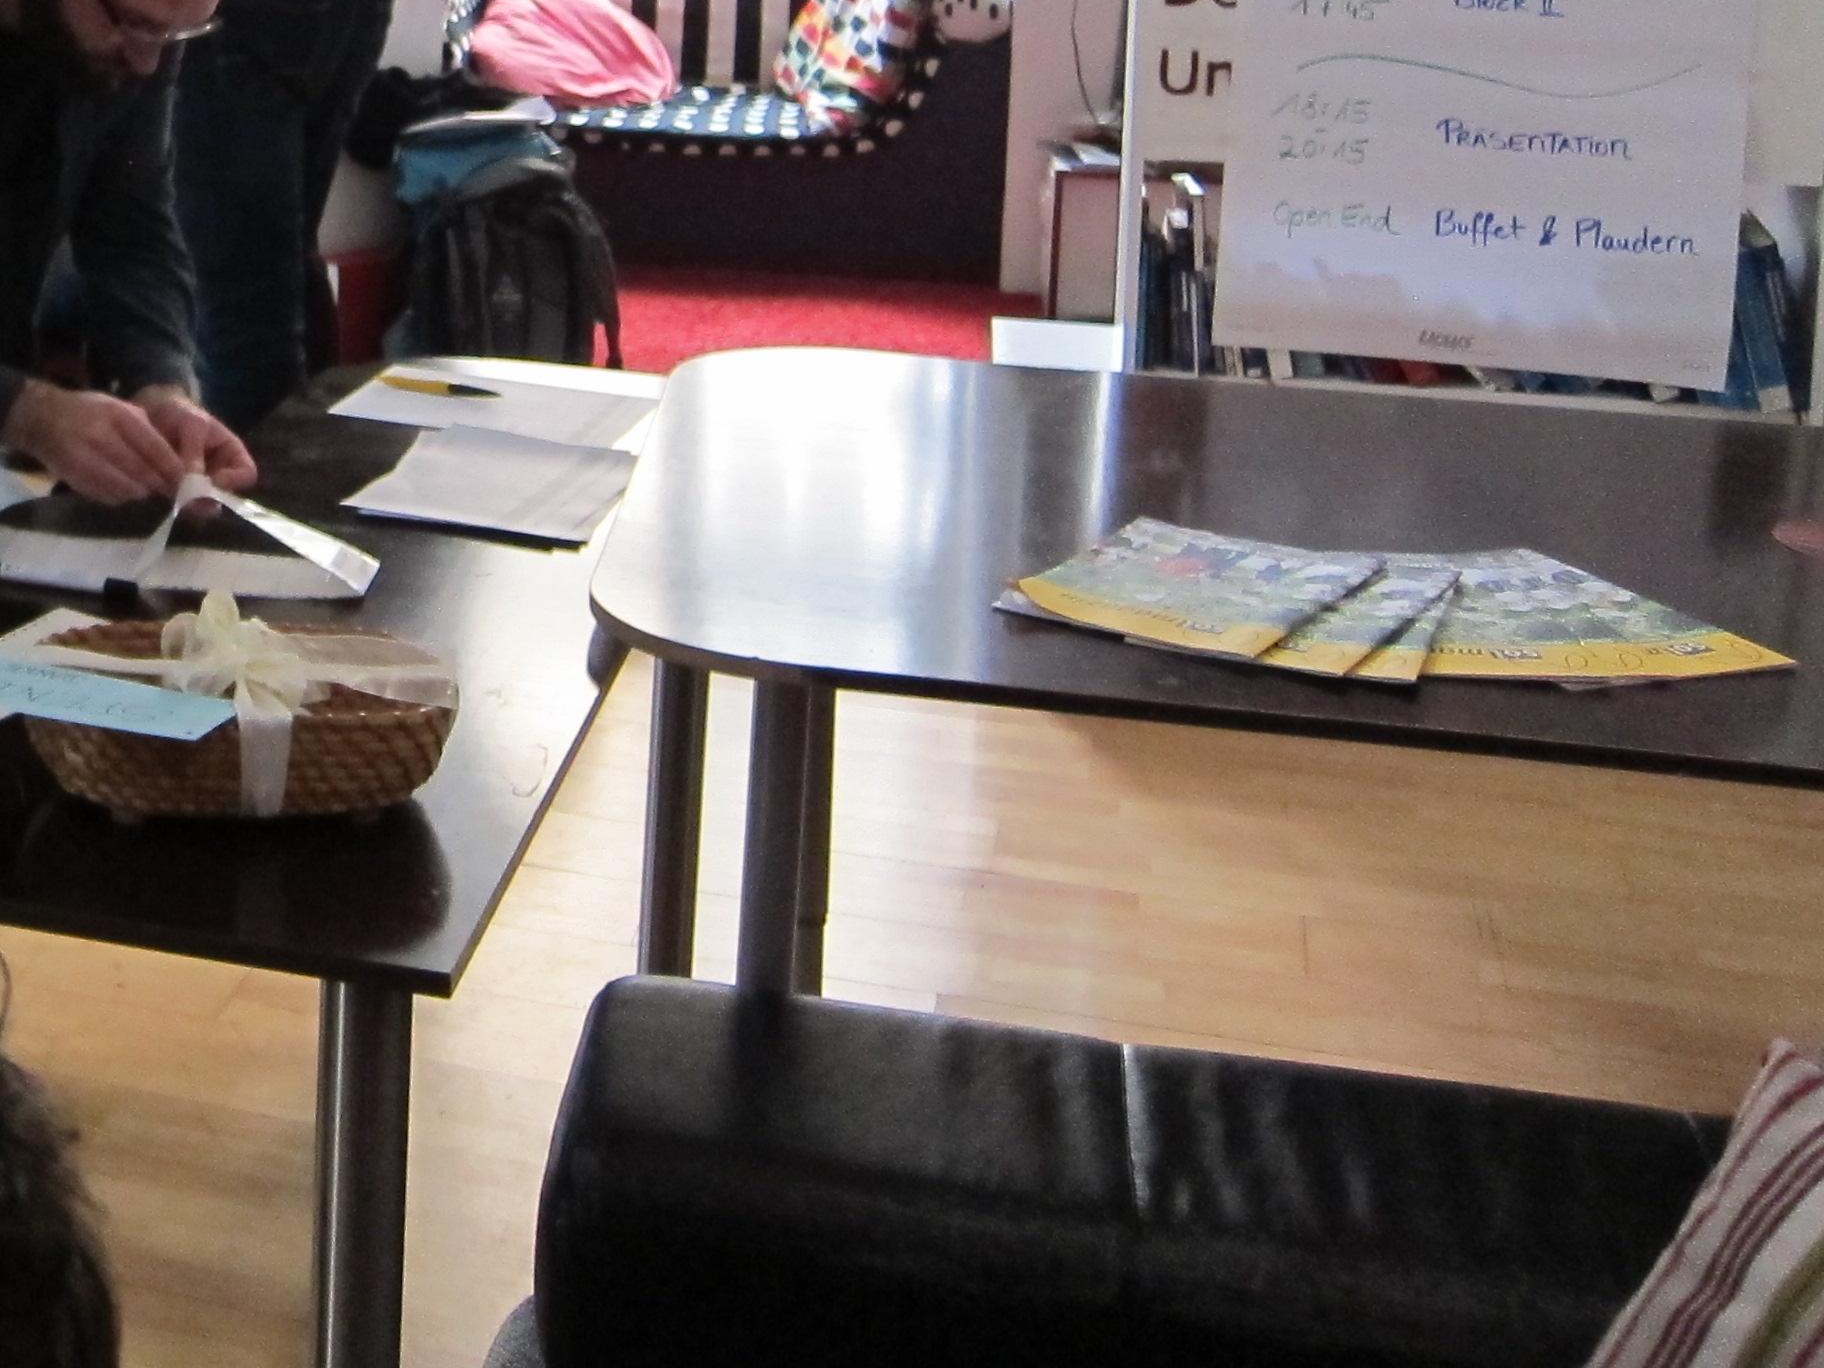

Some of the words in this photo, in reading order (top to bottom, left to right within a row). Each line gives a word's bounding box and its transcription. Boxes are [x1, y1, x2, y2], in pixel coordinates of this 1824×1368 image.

[1341, 203, 1400, 236] End
[1435, 209, 1526, 246] Buffet
[1576, 218, 1698, 256] Plaudern
